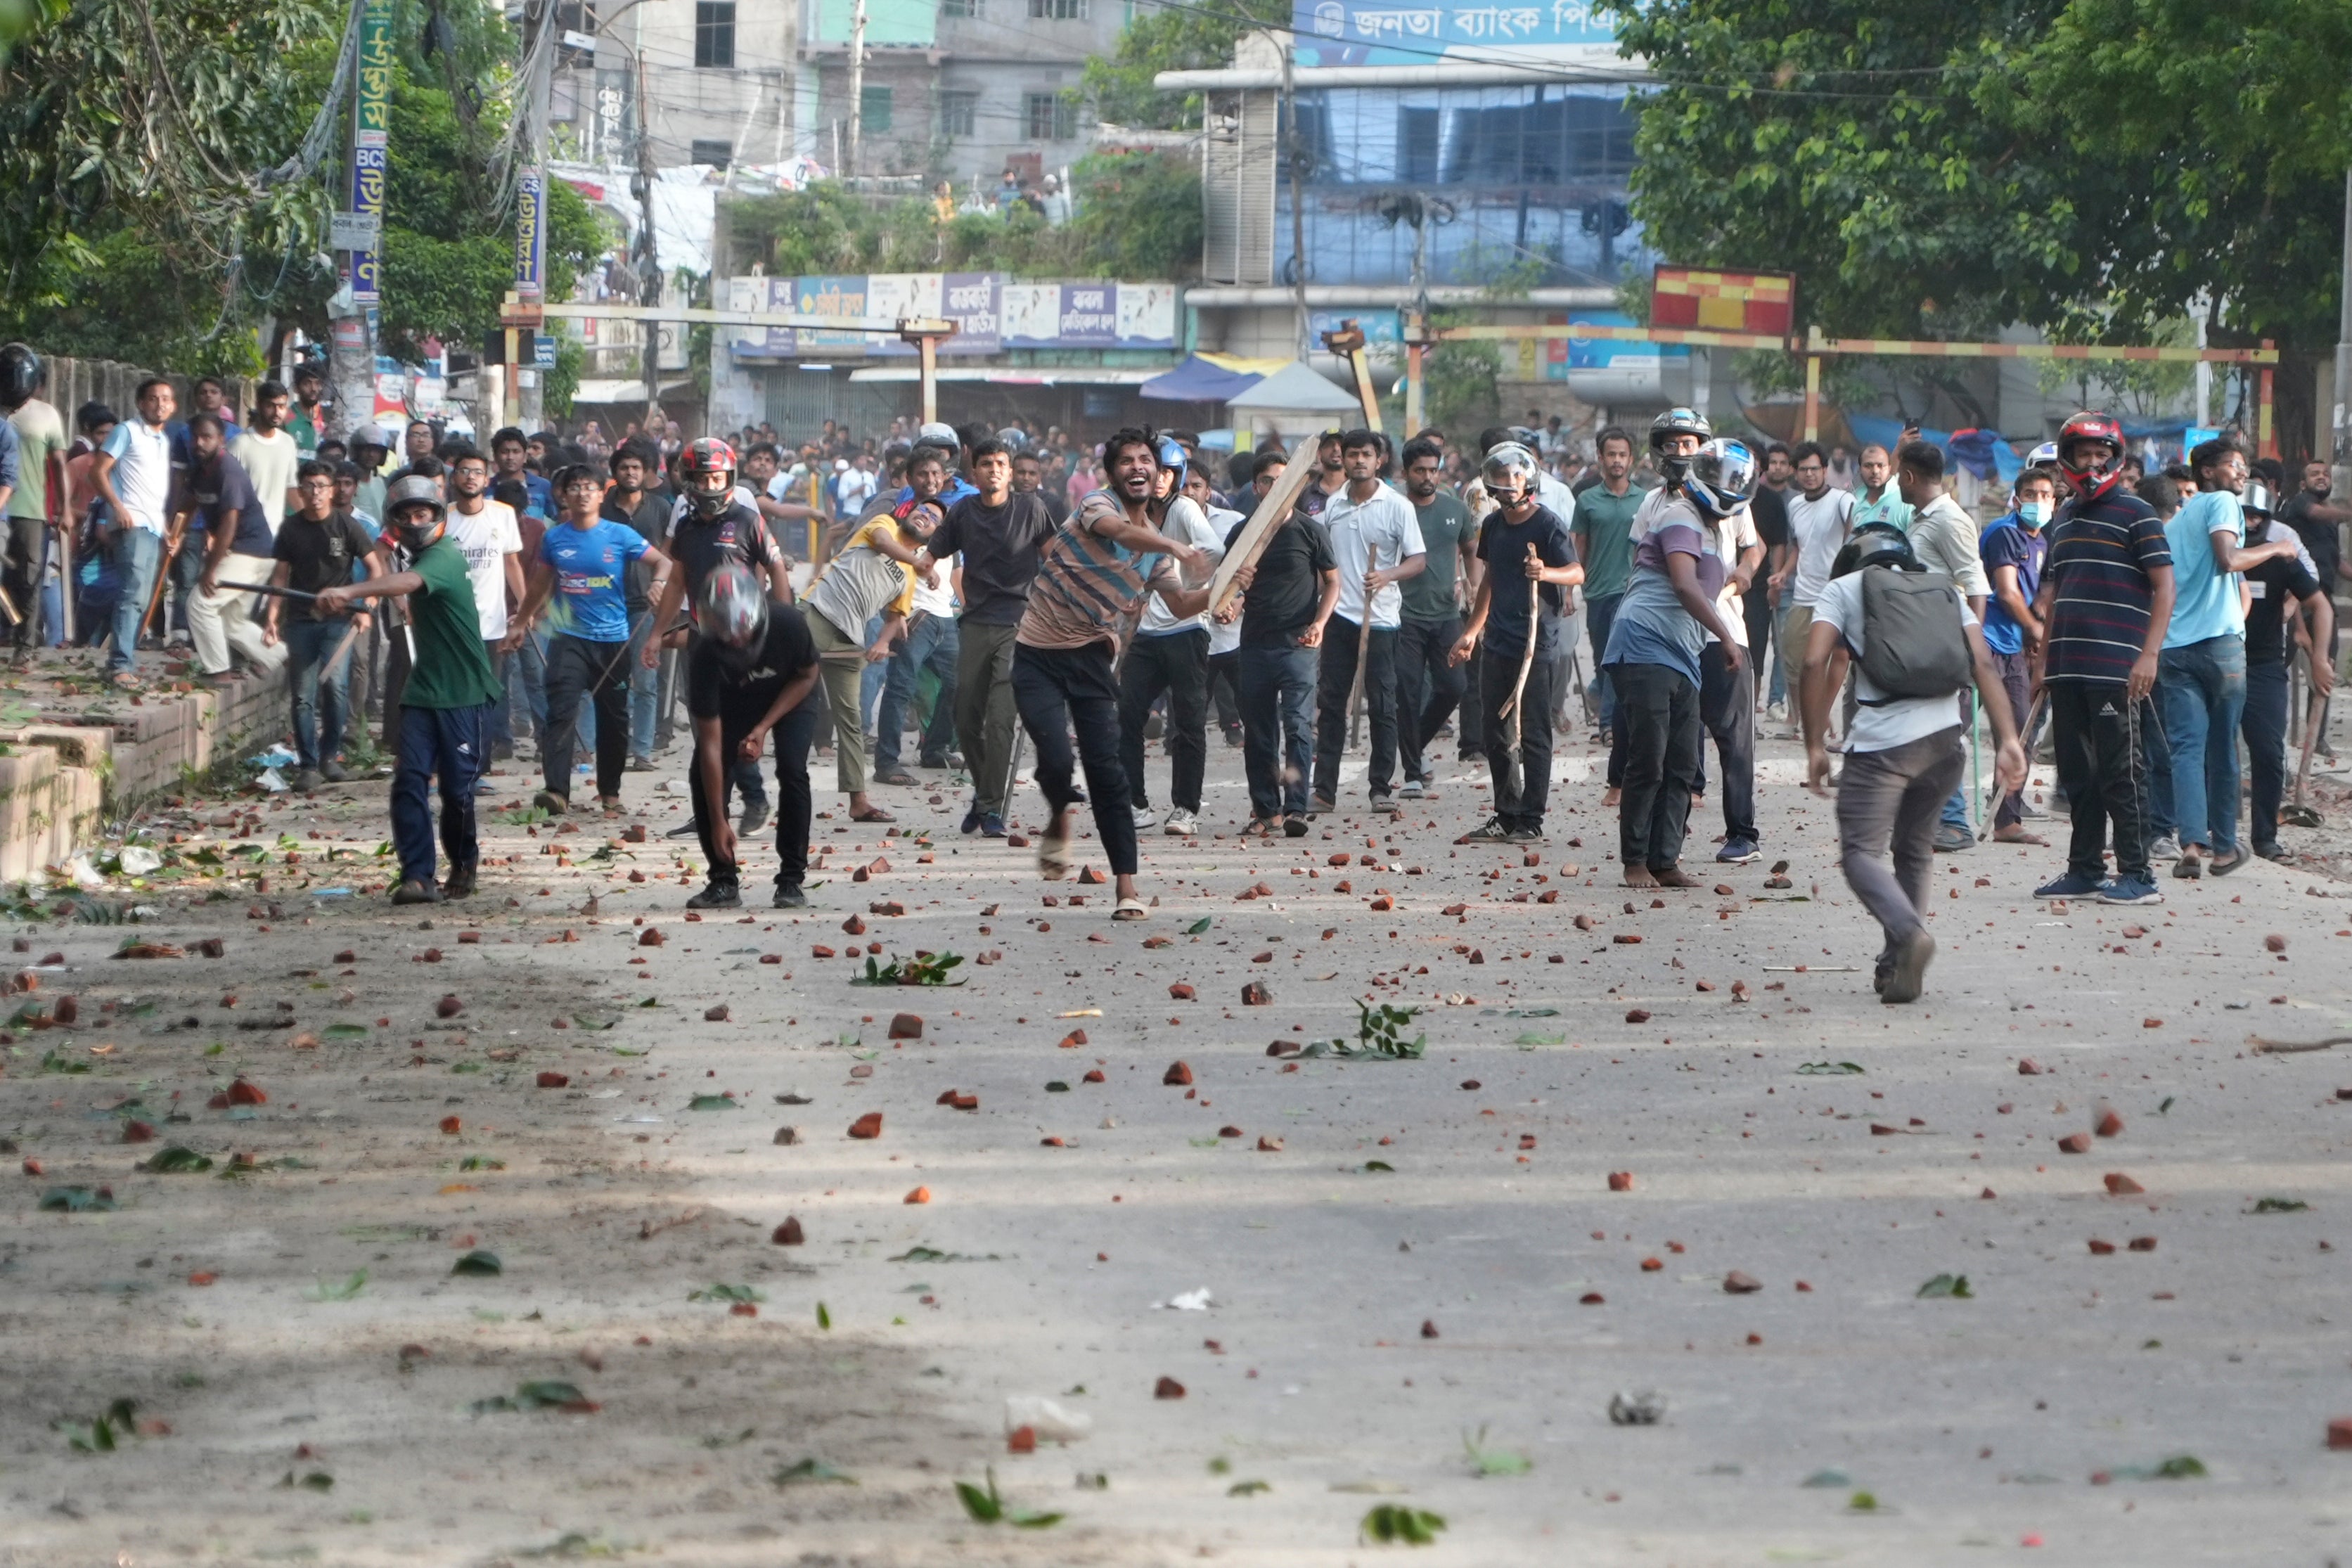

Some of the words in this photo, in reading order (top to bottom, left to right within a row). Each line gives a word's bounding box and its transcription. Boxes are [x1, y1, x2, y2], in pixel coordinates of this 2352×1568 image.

[1352, 6, 1443, 39] জনতা
[1451, 6, 1541, 38] ব্যাংক
[458, 546, 499, 558] mirates
